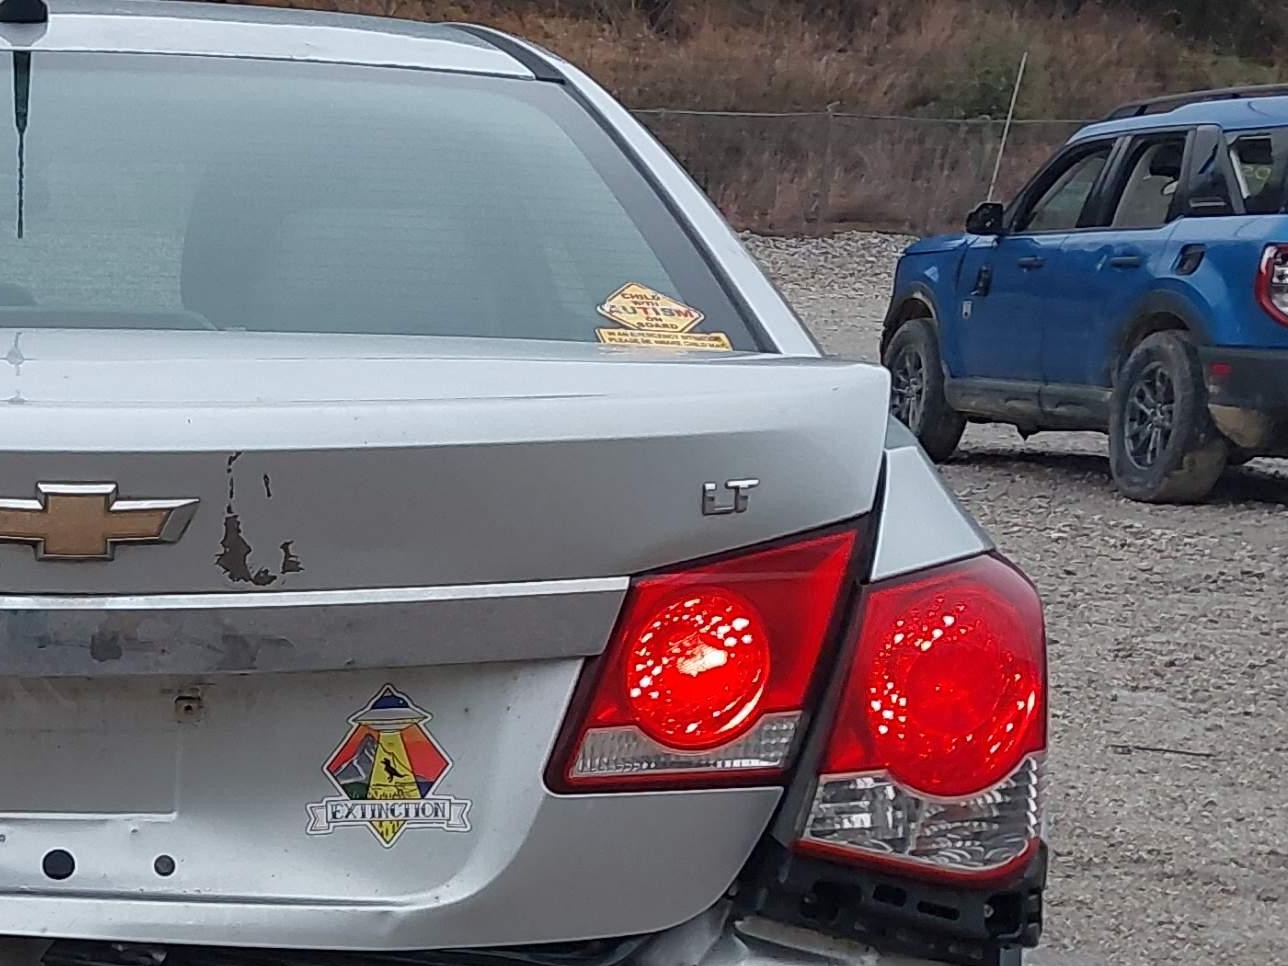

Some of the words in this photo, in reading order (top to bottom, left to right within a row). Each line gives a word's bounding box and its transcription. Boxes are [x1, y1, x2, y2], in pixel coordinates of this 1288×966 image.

[621, 293, 661, 301] CHILD
[608, 305, 695, 318] AUTISM
[636, 321, 679, 330] BOARD
[701, 477, 761, 516] LT
[330, 802, 447, 820] EXTINCTION
